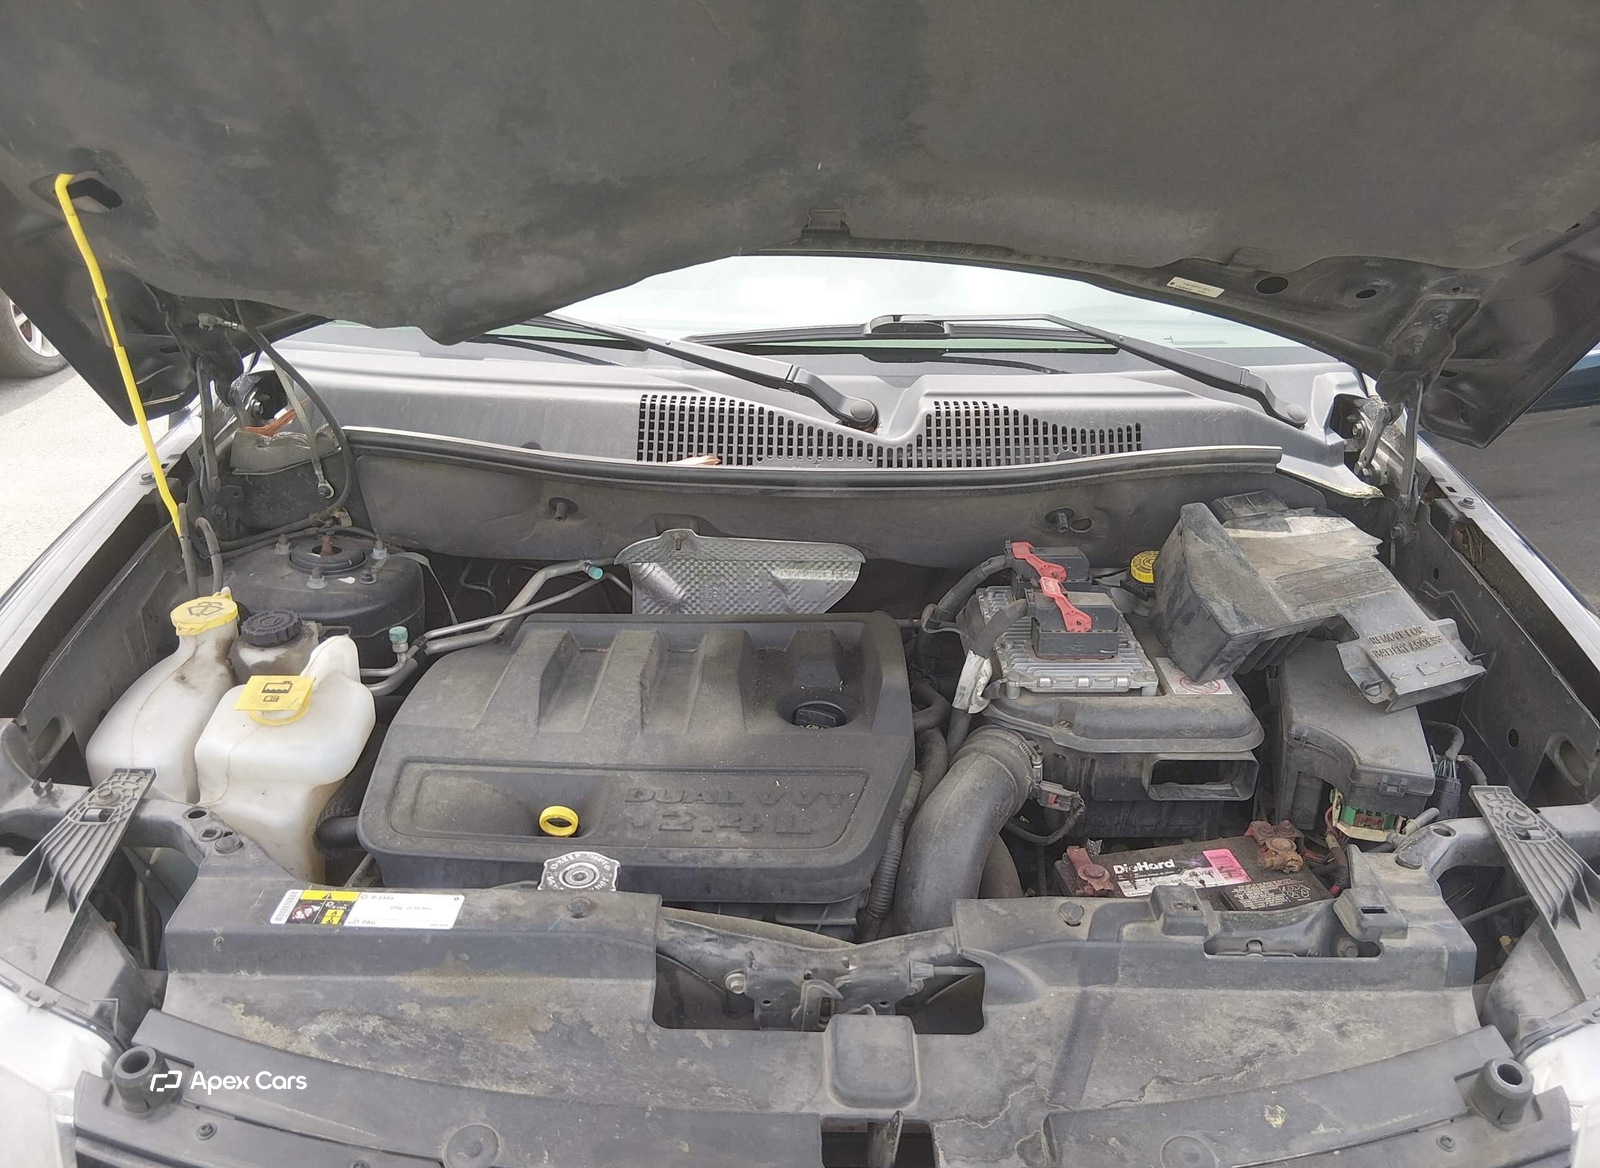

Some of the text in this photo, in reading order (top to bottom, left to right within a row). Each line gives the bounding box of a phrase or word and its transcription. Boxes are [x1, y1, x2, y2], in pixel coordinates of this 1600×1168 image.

[1368, 625, 1426, 645] REMOVE FOR
[1408, 635, 1444, 651] ACCESS
[624, 787, 745, 805] DUAL
[657, 810, 814, 835] 2.4L
